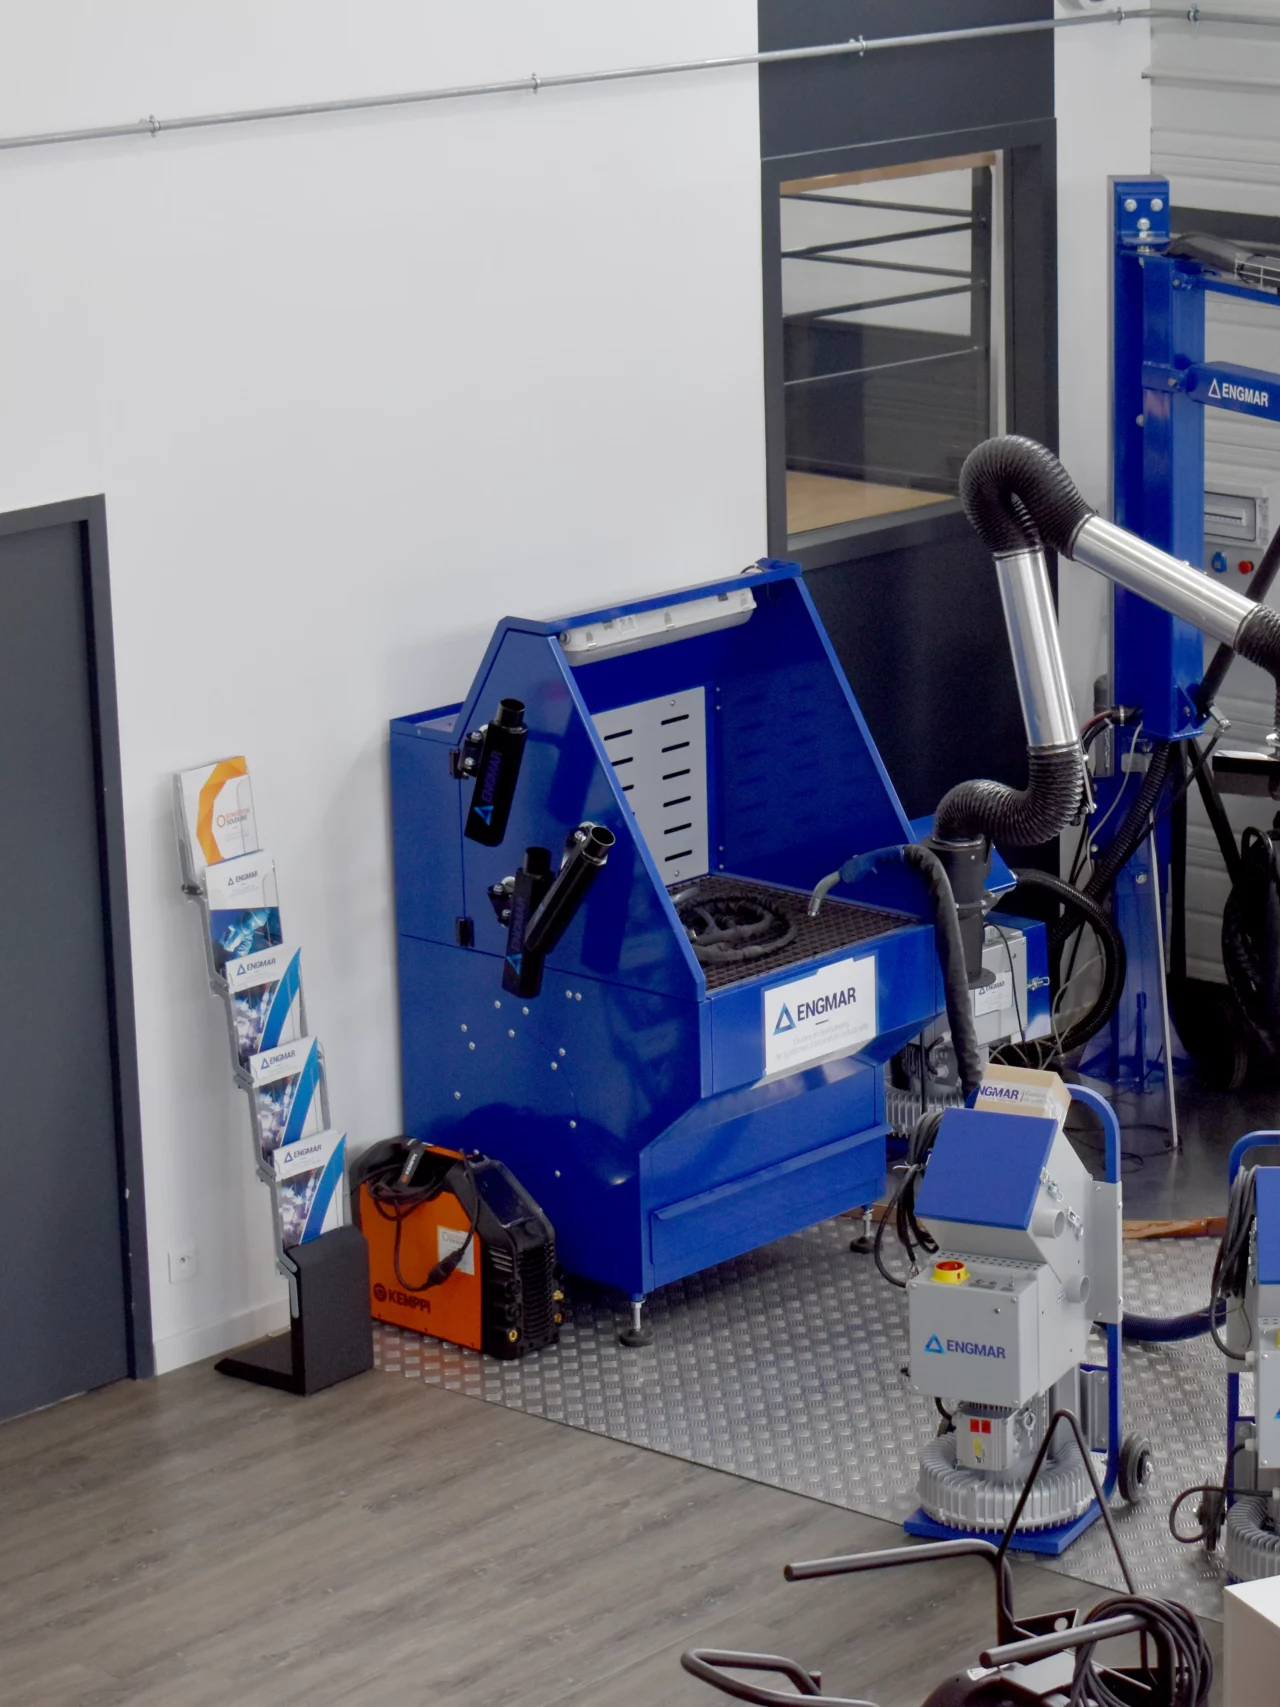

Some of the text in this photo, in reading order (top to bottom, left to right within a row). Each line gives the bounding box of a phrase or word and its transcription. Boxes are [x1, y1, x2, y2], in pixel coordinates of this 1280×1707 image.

[1221, 383, 1269, 408] ENGMAR
[480, 749, 503, 803] ENGMAR
[235, 870, 259, 884] ENGMAR
[510, 896, 527, 951] ENGMAR
[246, 957, 277, 972] ENGMAR
[797, 986, 857, 1022] ENGMAR
[269, 1049, 296, 1064] ENGMAR
[293, 1144, 322, 1159] ENGMAR
[404, 1152, 418, 1175] KEMPPI
[387, 1288, 432, 1314] KEMPPI
[946, 1338, 1006, 1360] ENGMAR
